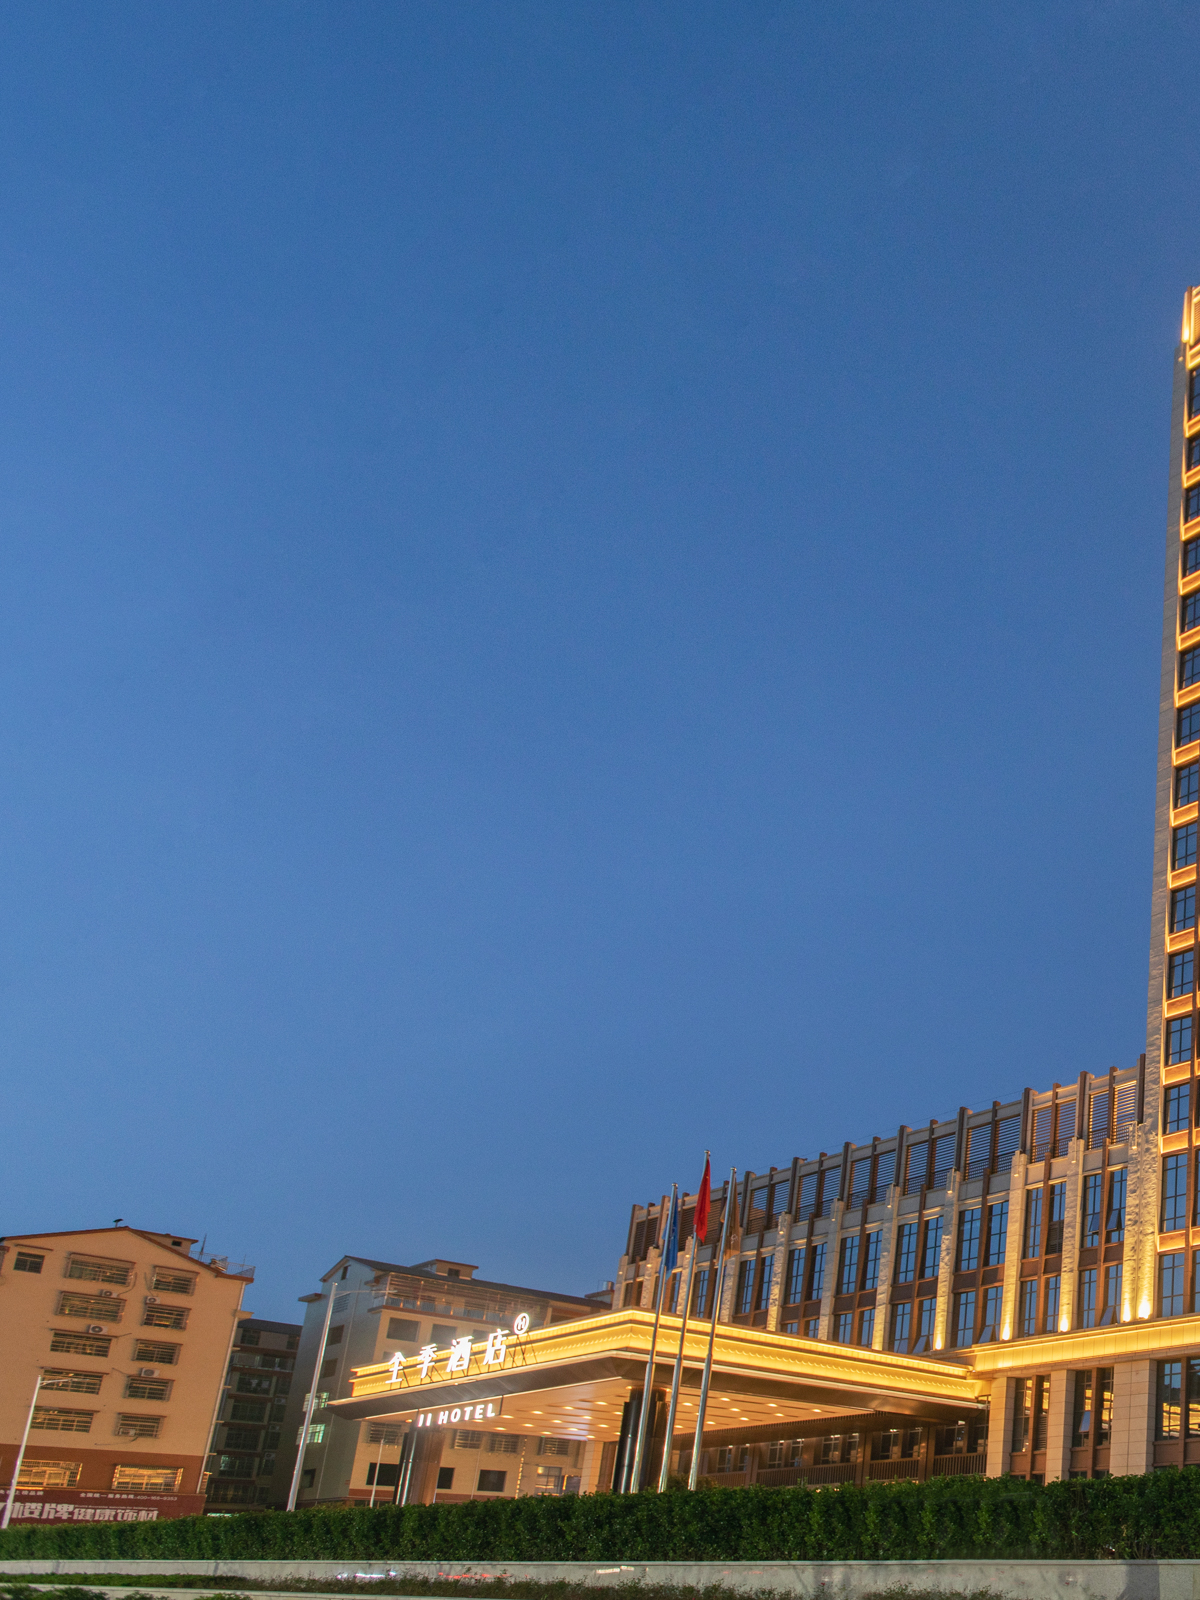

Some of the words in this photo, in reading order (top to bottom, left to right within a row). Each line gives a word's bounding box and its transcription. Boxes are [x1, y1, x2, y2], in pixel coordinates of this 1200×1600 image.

[385, 1328, 510, 1384] 全季酒店
[438, 1403, 496, 1425] HOTEL
[0, 1502, 159, 1522] 楼牌健康饰材
